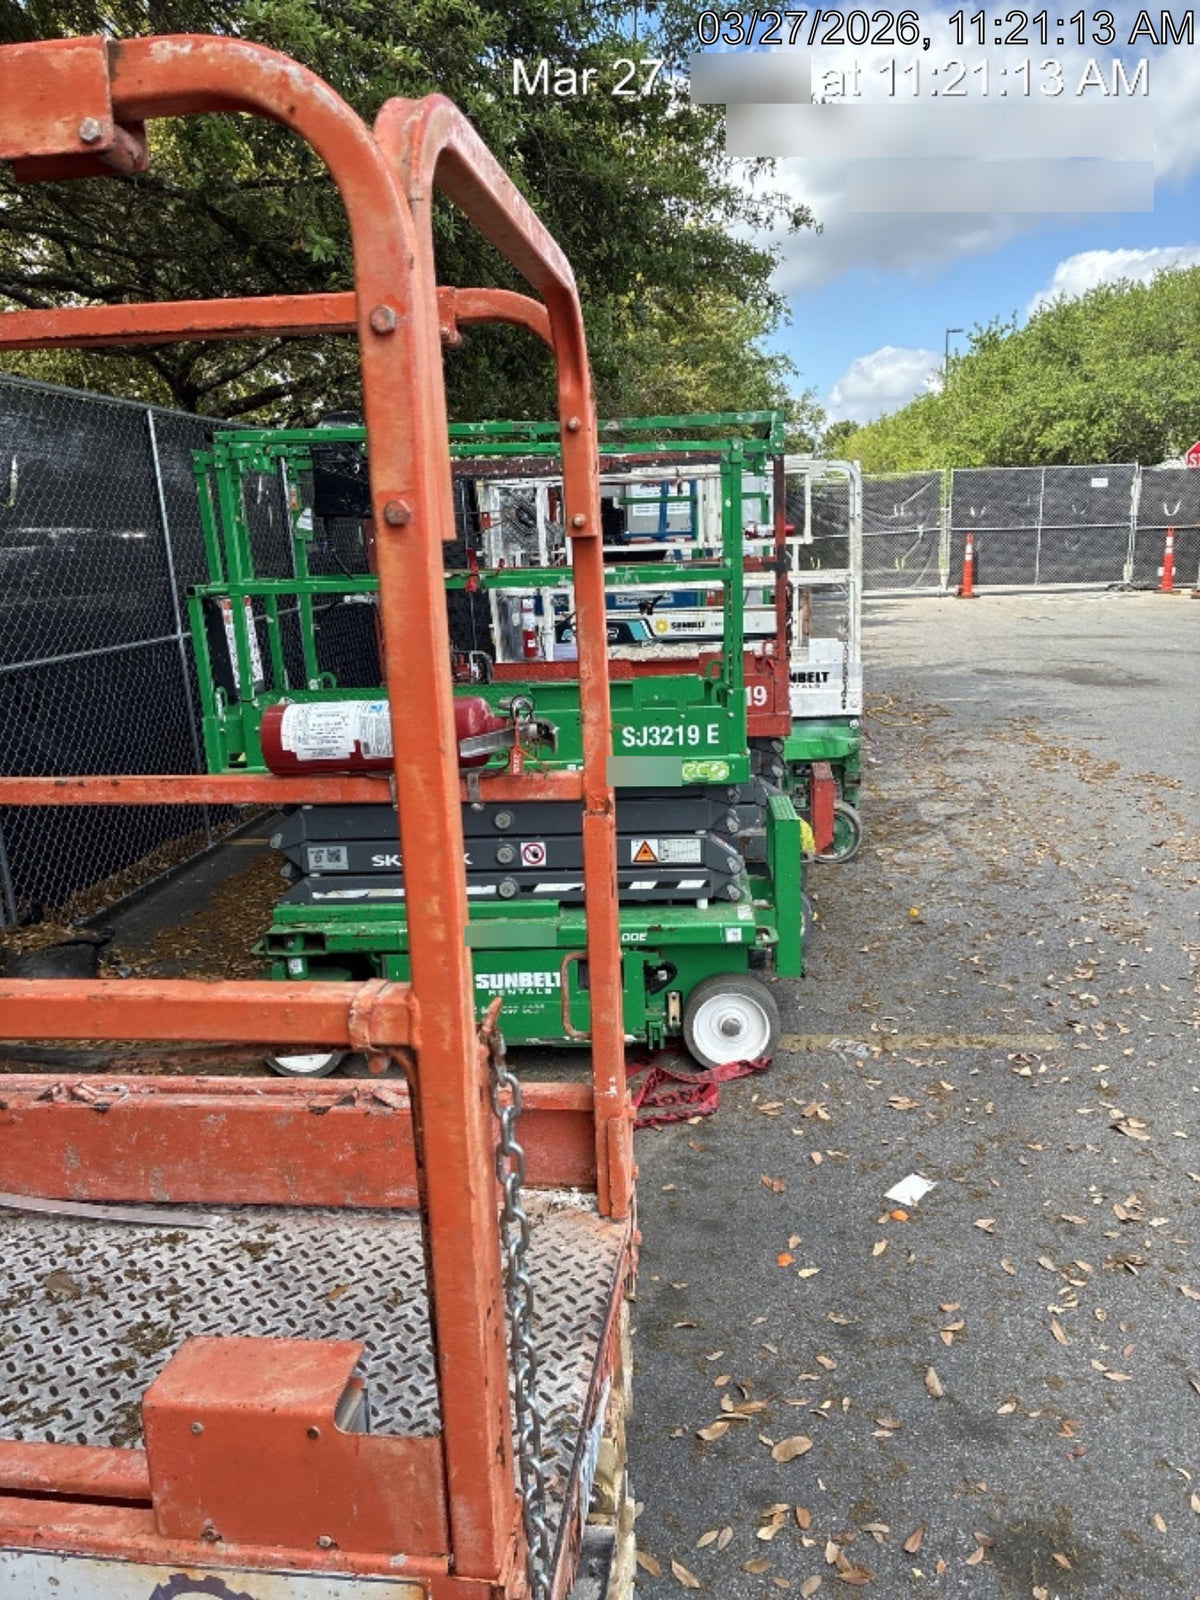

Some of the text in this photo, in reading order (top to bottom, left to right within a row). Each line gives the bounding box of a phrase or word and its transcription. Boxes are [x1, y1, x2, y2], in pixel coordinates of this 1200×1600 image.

[622, 723, 720, 746] SJ3219 E
[475, 971, 561, 990] SUNBELT
